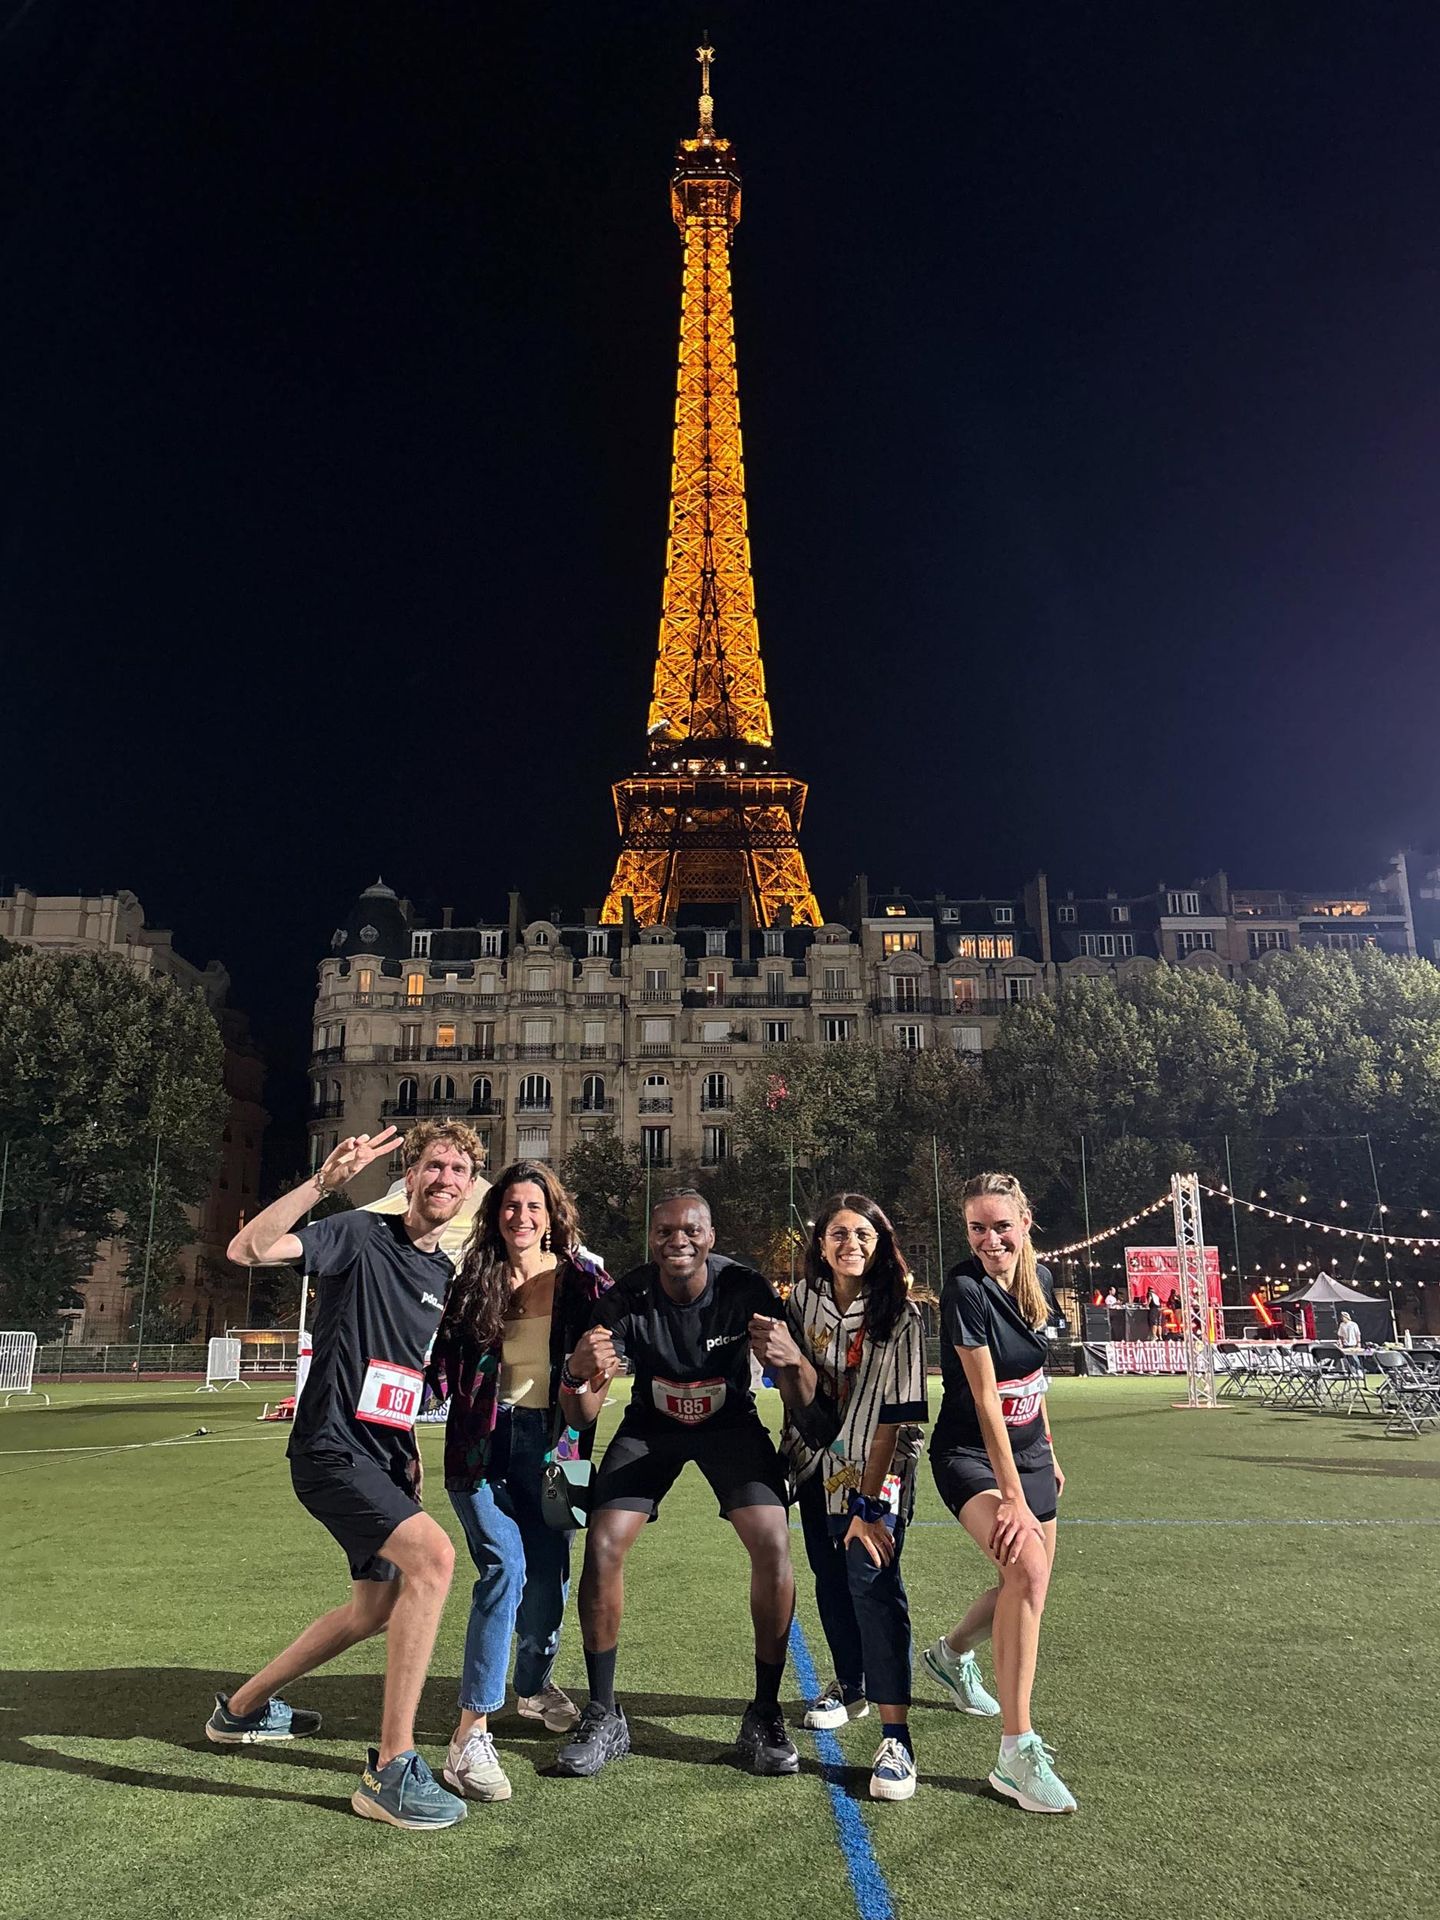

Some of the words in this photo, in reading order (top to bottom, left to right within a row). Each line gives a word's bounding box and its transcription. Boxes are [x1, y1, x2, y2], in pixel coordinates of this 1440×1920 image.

[1116, 1347, 1167, 1364] ELEVATOR
[389, 1387, 411, 1413] 187
[675, 1398, 704, 1415] 185
[1010, 1395, 1035, 1416] 190
